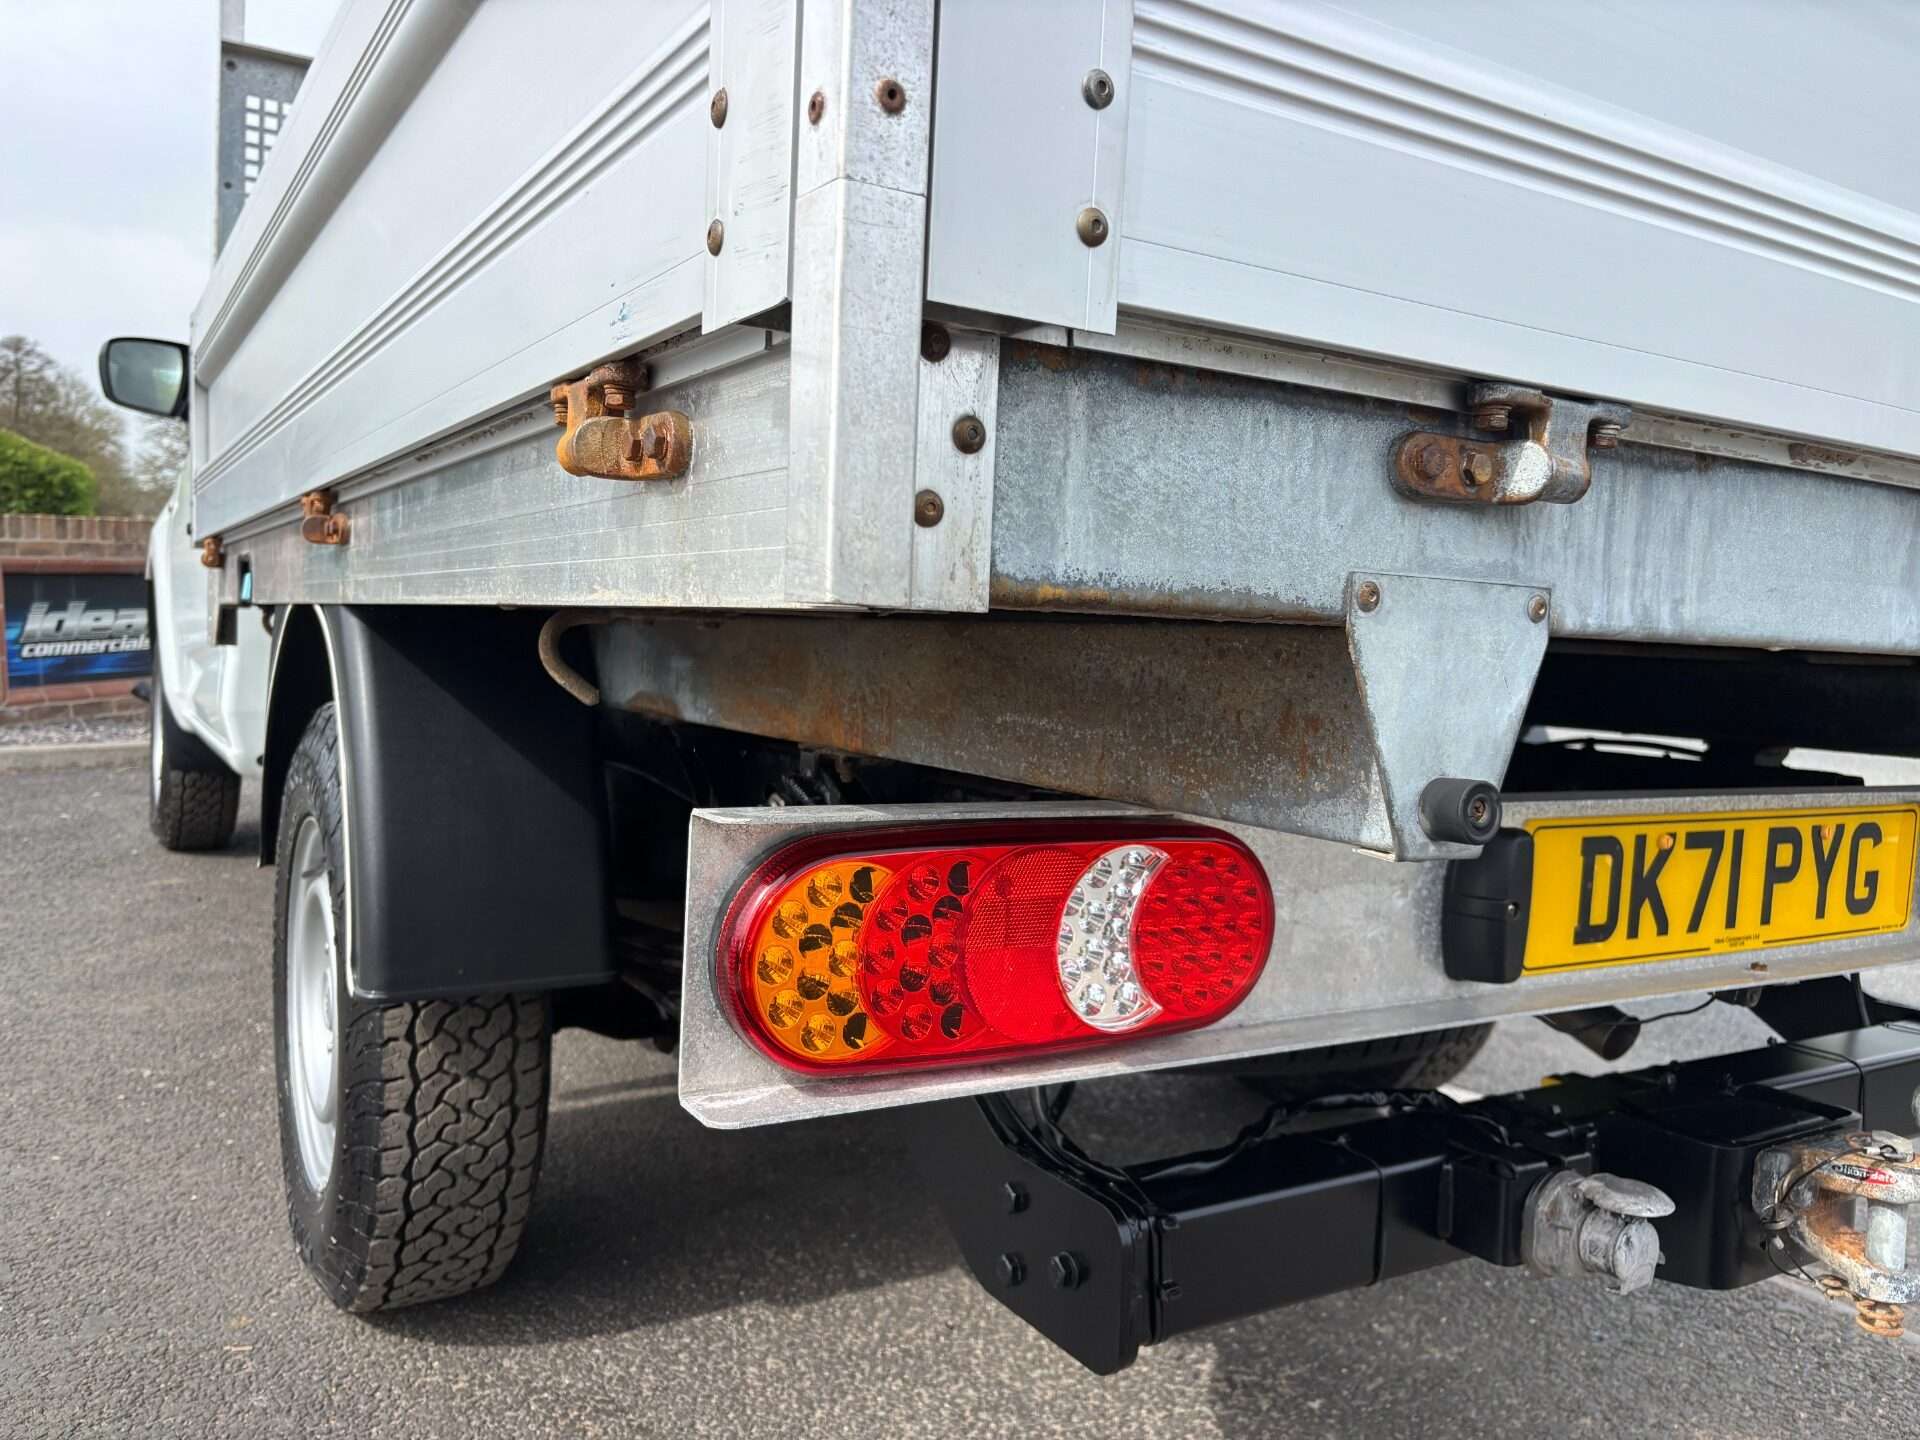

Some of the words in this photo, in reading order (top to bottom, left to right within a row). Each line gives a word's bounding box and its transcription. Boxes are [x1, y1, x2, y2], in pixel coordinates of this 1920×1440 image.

[21, 601, 149, 642] Idea
[1573, 829, 1746, 945] DK71
[1760, 822, 1883, 926] PYG
